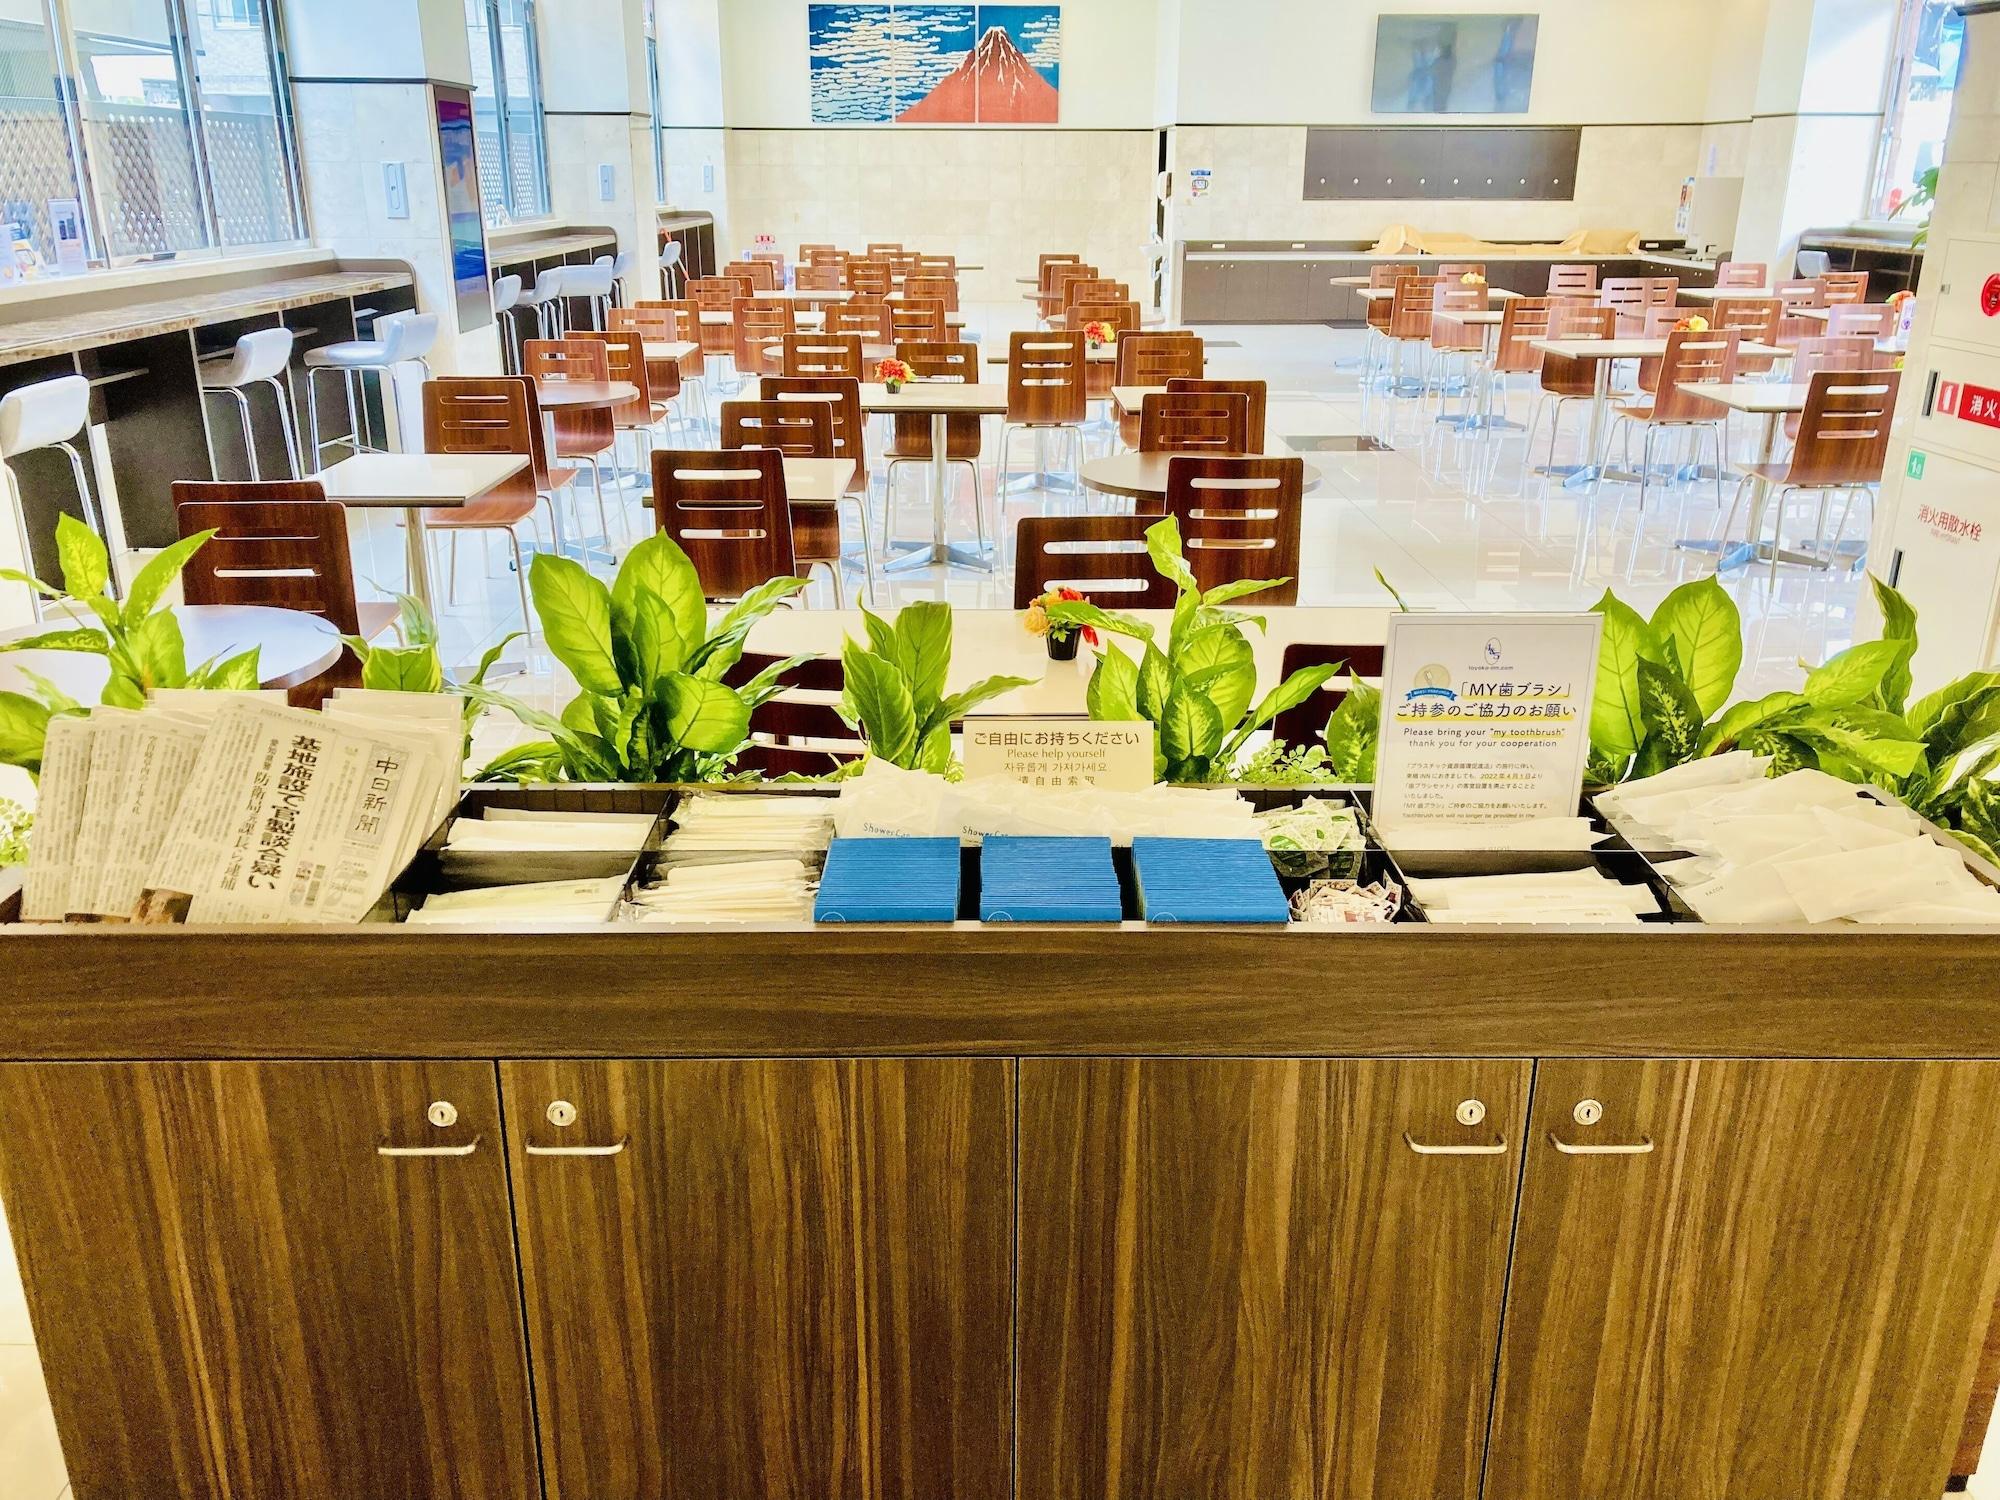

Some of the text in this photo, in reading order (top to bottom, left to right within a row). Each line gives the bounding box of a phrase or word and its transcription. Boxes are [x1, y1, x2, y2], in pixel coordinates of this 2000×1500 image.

[1969, 394, 2000, 421] 消火
[1917, 503, 1982, 542] 消火用散水栓
[1461, 681, 1571, 698] 「MY歯ブラシ」
[1396, 703, 1577, 718] ご持参のご協力のお願い
[974, 732, 1139, 746] ご自由にお持ちください
[1403, 728, 1434, 736] Please
[1437, 728, 1462, 738] bring
[1465, 730, 1486, 738] your
[1409, 739, 1557, 749] thank you for your cooperation
[1006, 748, 1106, 760] Please help yourself
[1004, 762, 1108, 773] 자유롭게 가져가세요
[355, 756, 400, 836] 中日新聞
[248, 735, 323, 890] 基地施設で官製談合疑い
